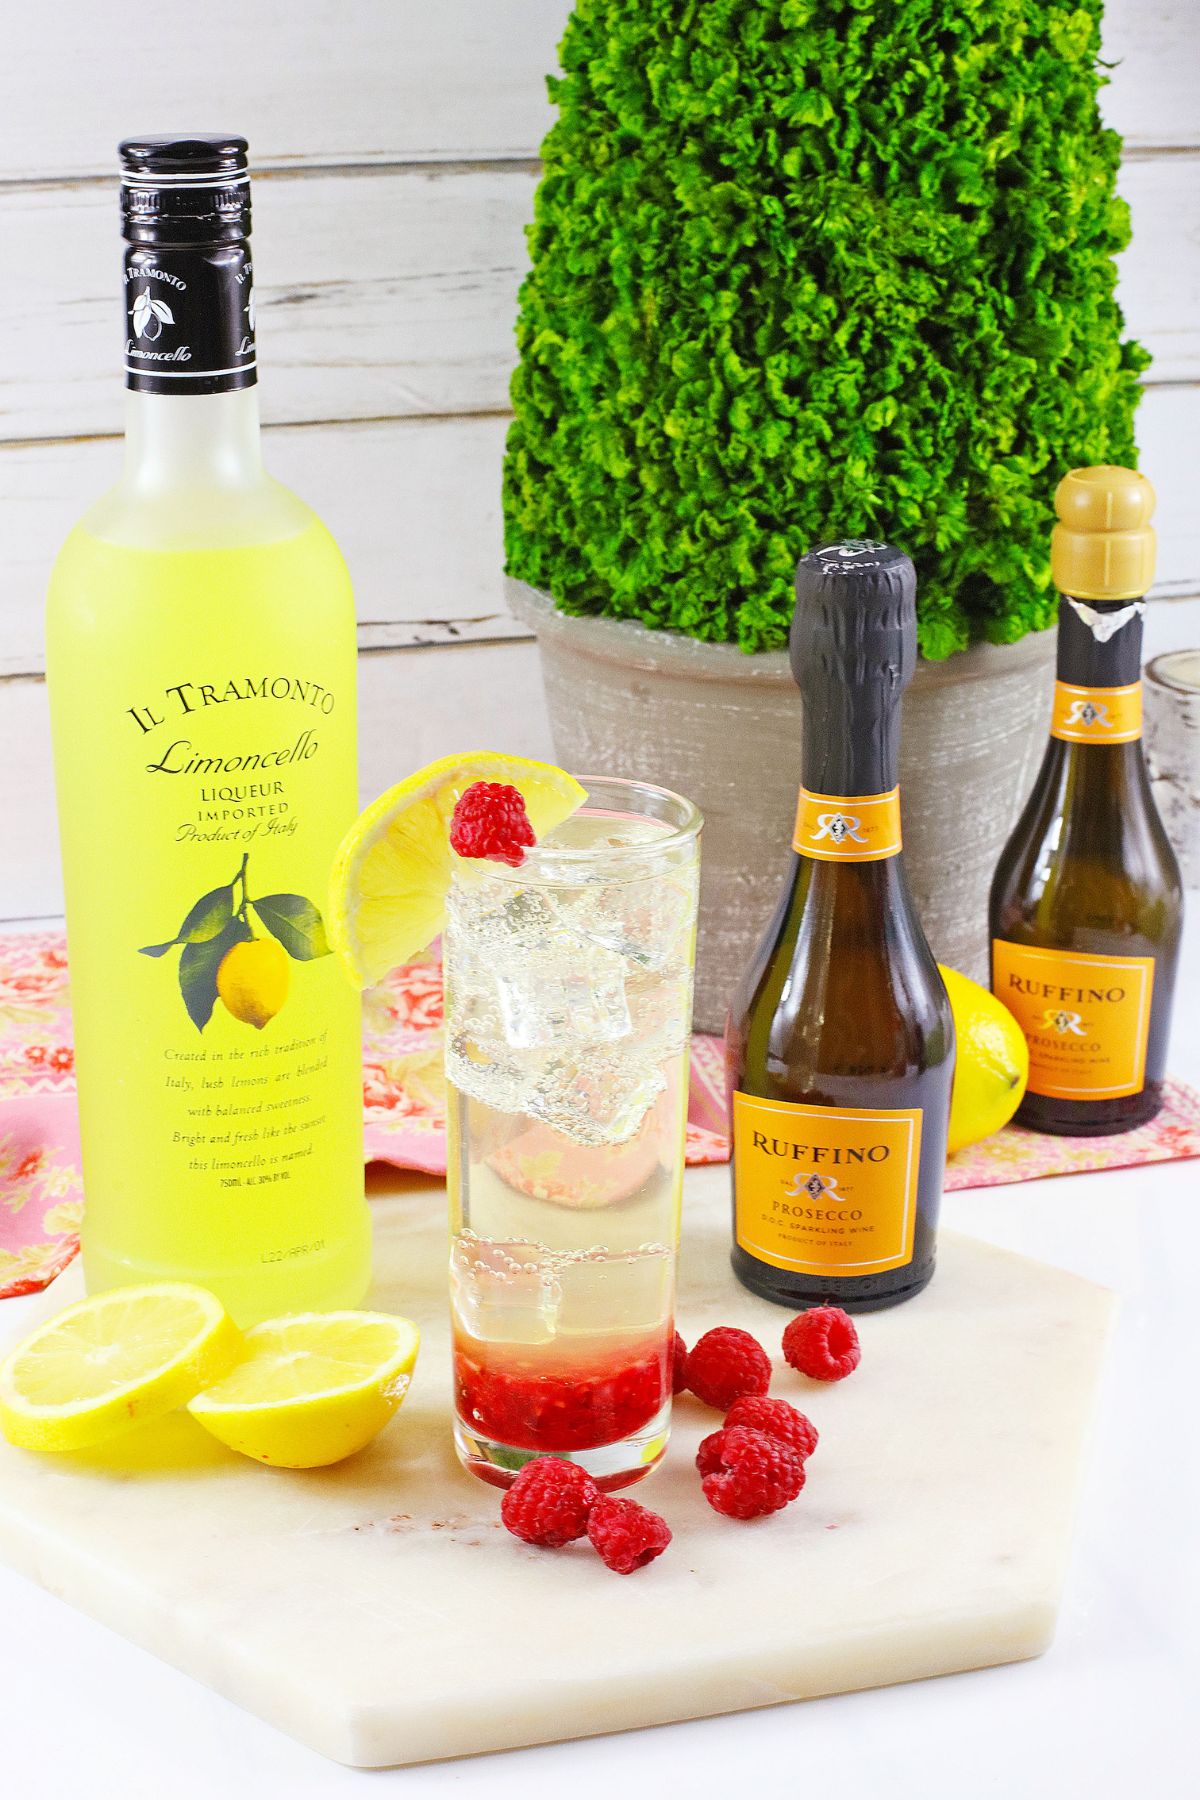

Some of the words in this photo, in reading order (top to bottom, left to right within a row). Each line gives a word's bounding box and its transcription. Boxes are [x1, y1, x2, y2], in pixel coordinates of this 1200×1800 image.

[127, 267, 187, 291] TRAMONTO
[124, 339, 192, 362] Limoncello
[126, 707, 165, 735] IL
[165, 677, 335, 715] TRAMONTO
[145, 729, 318, 774] Limoncello
[201, 781, 284, 803] LIQUEUR
[198, 802, 289, 822] IMPORTED
[175, 823, 240, 842] Product
[242, 822, 262, 843] of
[260, 815, 299, 837] Italy
[1009, 973, 1126, 1003] RUFFINO
[164, 1048, 207, 1061] Created
[212, 1052, 223, 1061] in
[229, 1048, 245, 1060] the
[250, 1044, 270, 1058] rich
[165, 1076, 194, 1092] Italy,
[201, 1076, 224, 1089] lush
[231, 1076, 268, 1088] lemons
[275, 1072, 290, 1082] are
[187, 1105, 212, 1117] with
[216, 1100, 263, 1116] balanced
[172, 1131, 206, 1147] Bright
[209, 1131, 231, 1143] and
[231, 1129, 259, 1146] fresh
[262, 1126, 280, 1139] like
[752, 1129, 890, 1165] RUFFINO
[188, 1158, 208, 1170] this
[211, 1154, 266, 1170] limoncello
[281, 1143, 313, 1162] named
[772, 1200, 863, 1222] PROSECCO
[789, 1221, 845, 1235] SPARKLING
[849, 1225, 876, 1233] WINE
